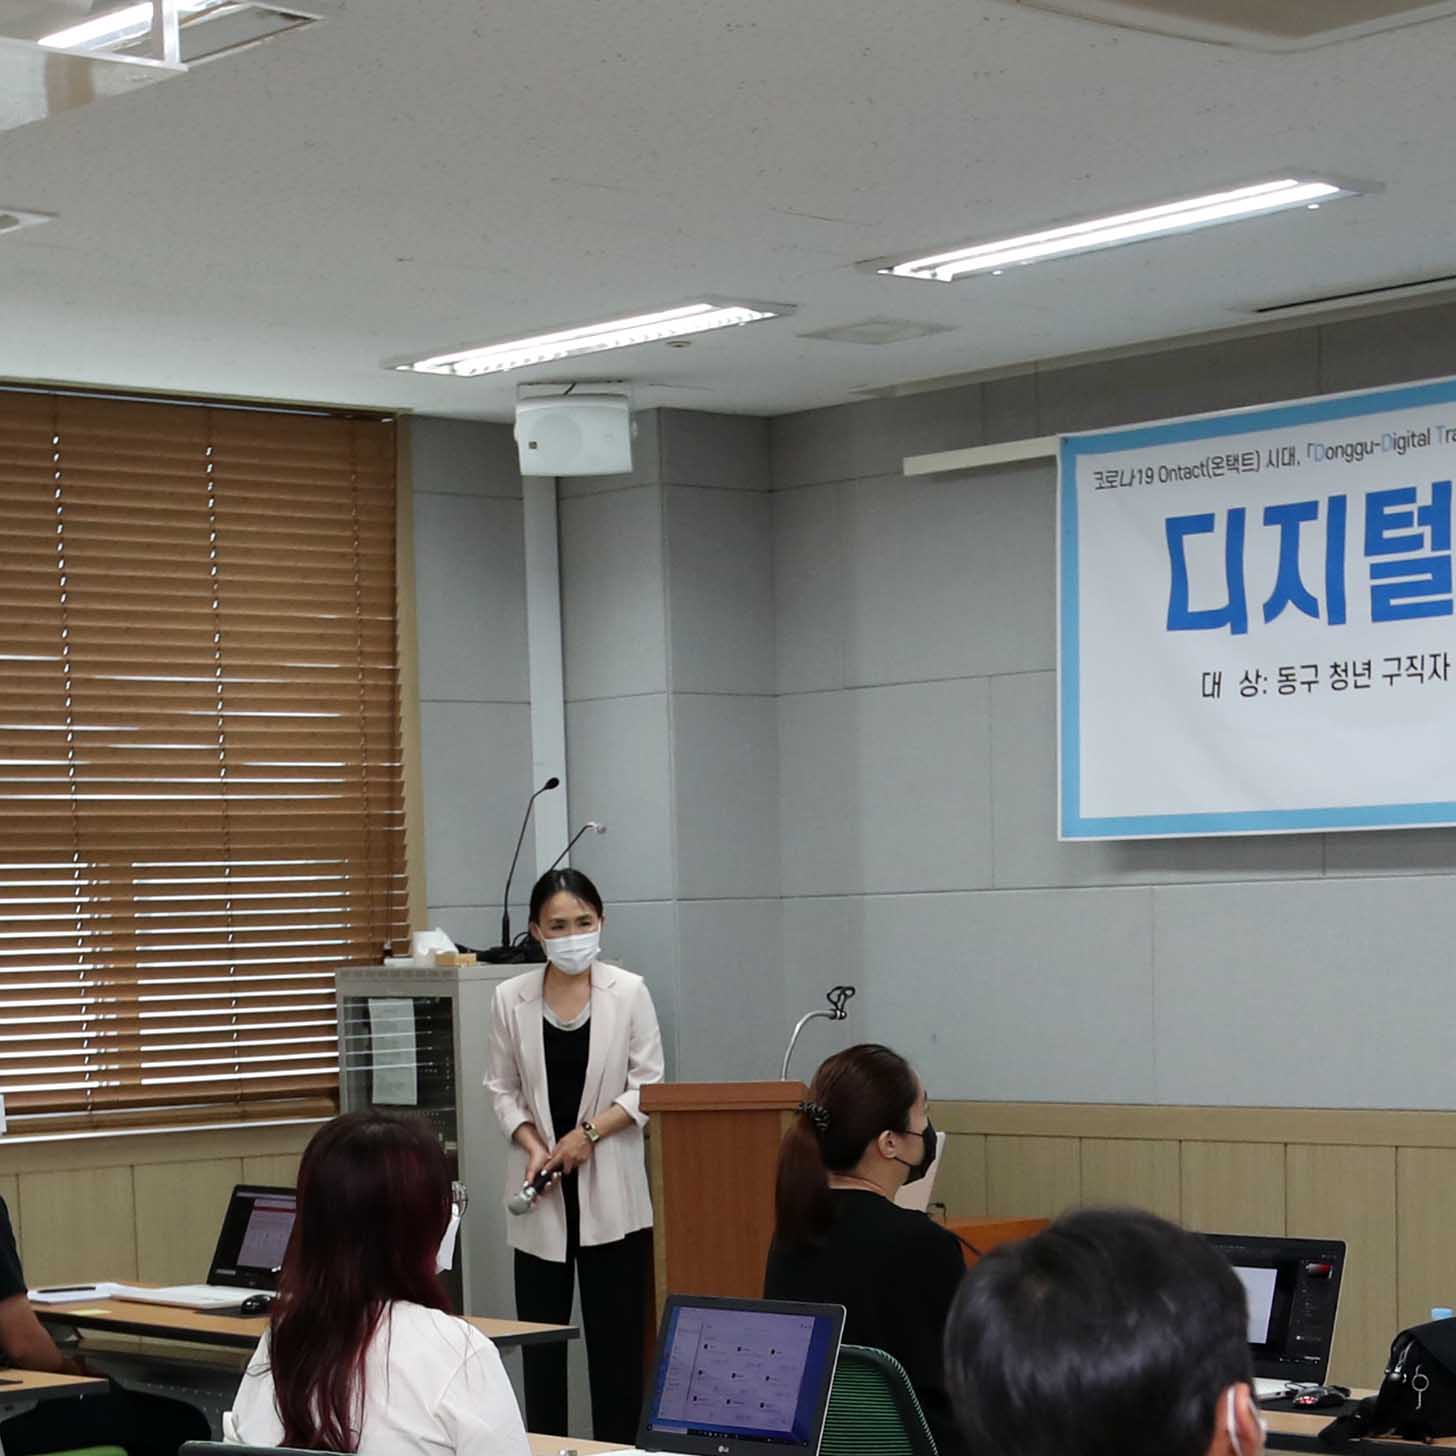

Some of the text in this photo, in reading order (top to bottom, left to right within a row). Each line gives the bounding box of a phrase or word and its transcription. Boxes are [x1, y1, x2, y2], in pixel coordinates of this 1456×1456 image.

[1093, 466, 1154, 490] 코로나19
[1157, 450, 1261, 483] Ontact(온택트)
[1164, 480, 1455, 636] 디지털
[1201, 651, 1452, 699] 대 상: 동구 청년 구직자
